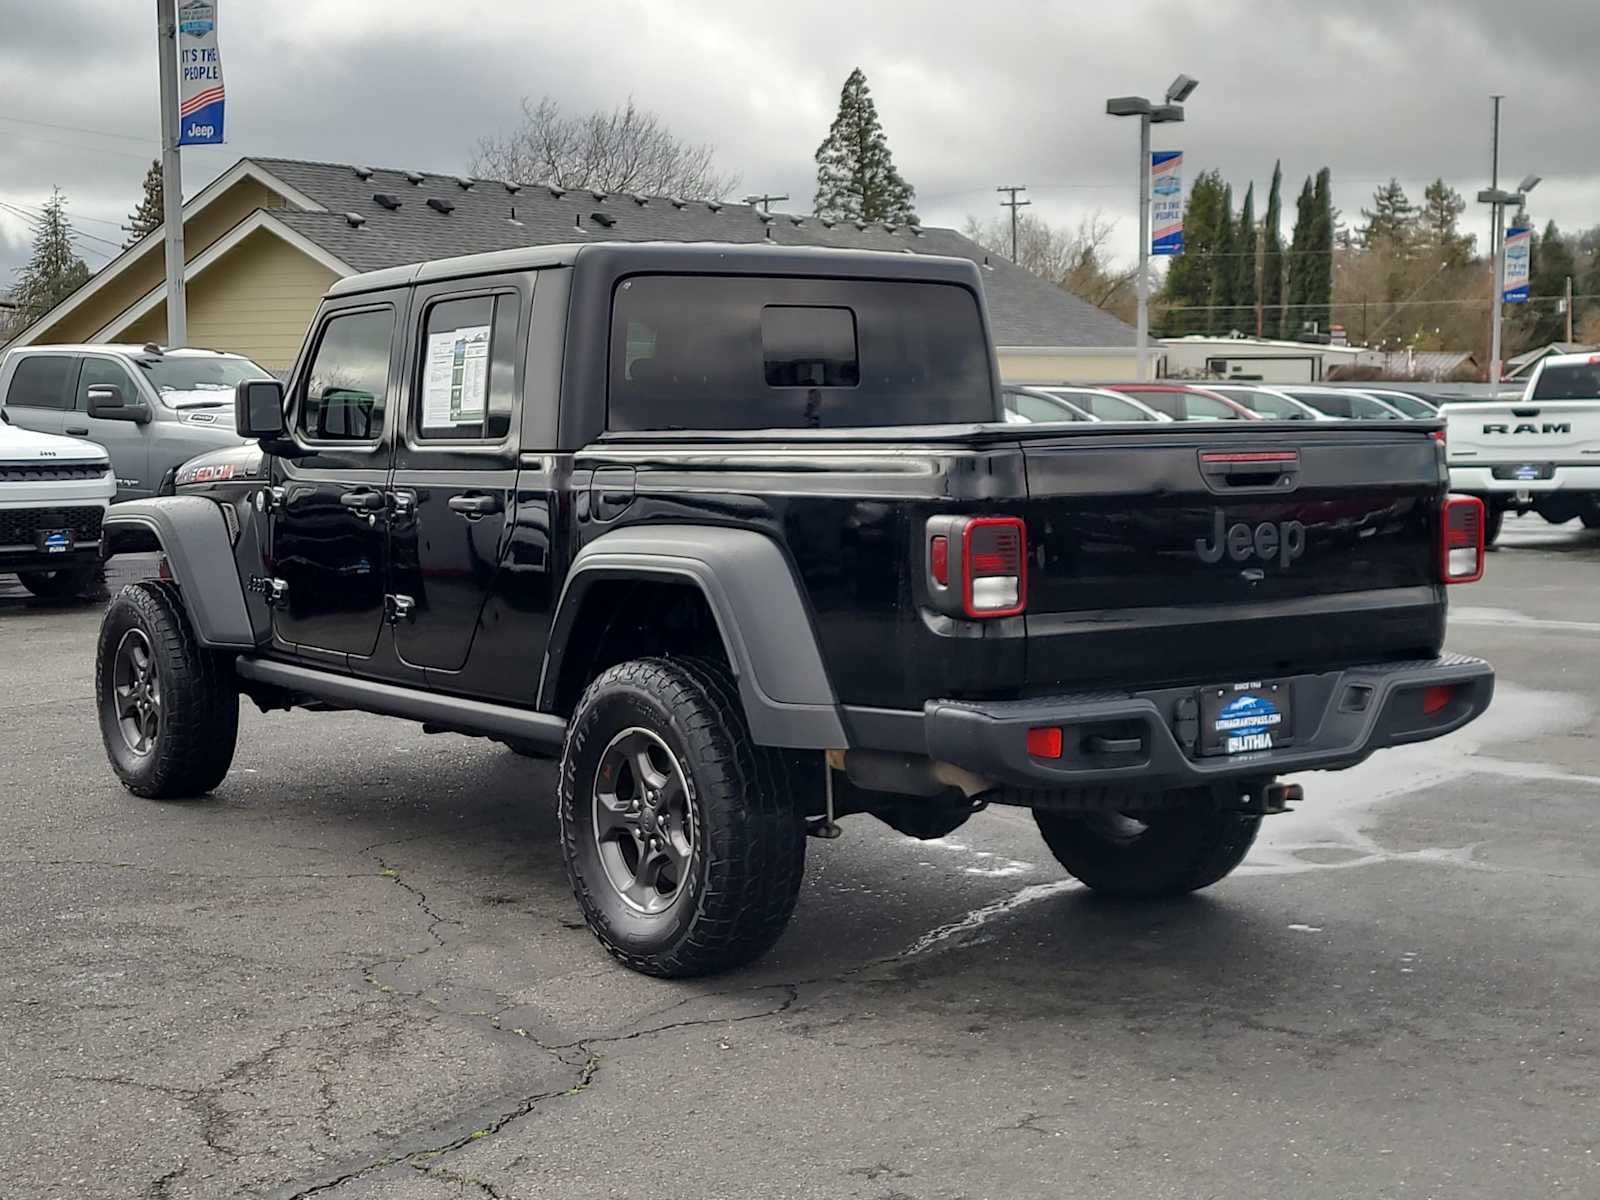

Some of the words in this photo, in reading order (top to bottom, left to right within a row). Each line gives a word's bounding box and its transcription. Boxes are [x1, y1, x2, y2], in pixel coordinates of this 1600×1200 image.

[200, 48, 217, 62] THE
[184, 66, 219, 80] PEOPLE
[187, 122, 214, 139] Jeep
[1482, 422, 1571, 435] RAM
[1195, 506, 1306, 569] Jeep
